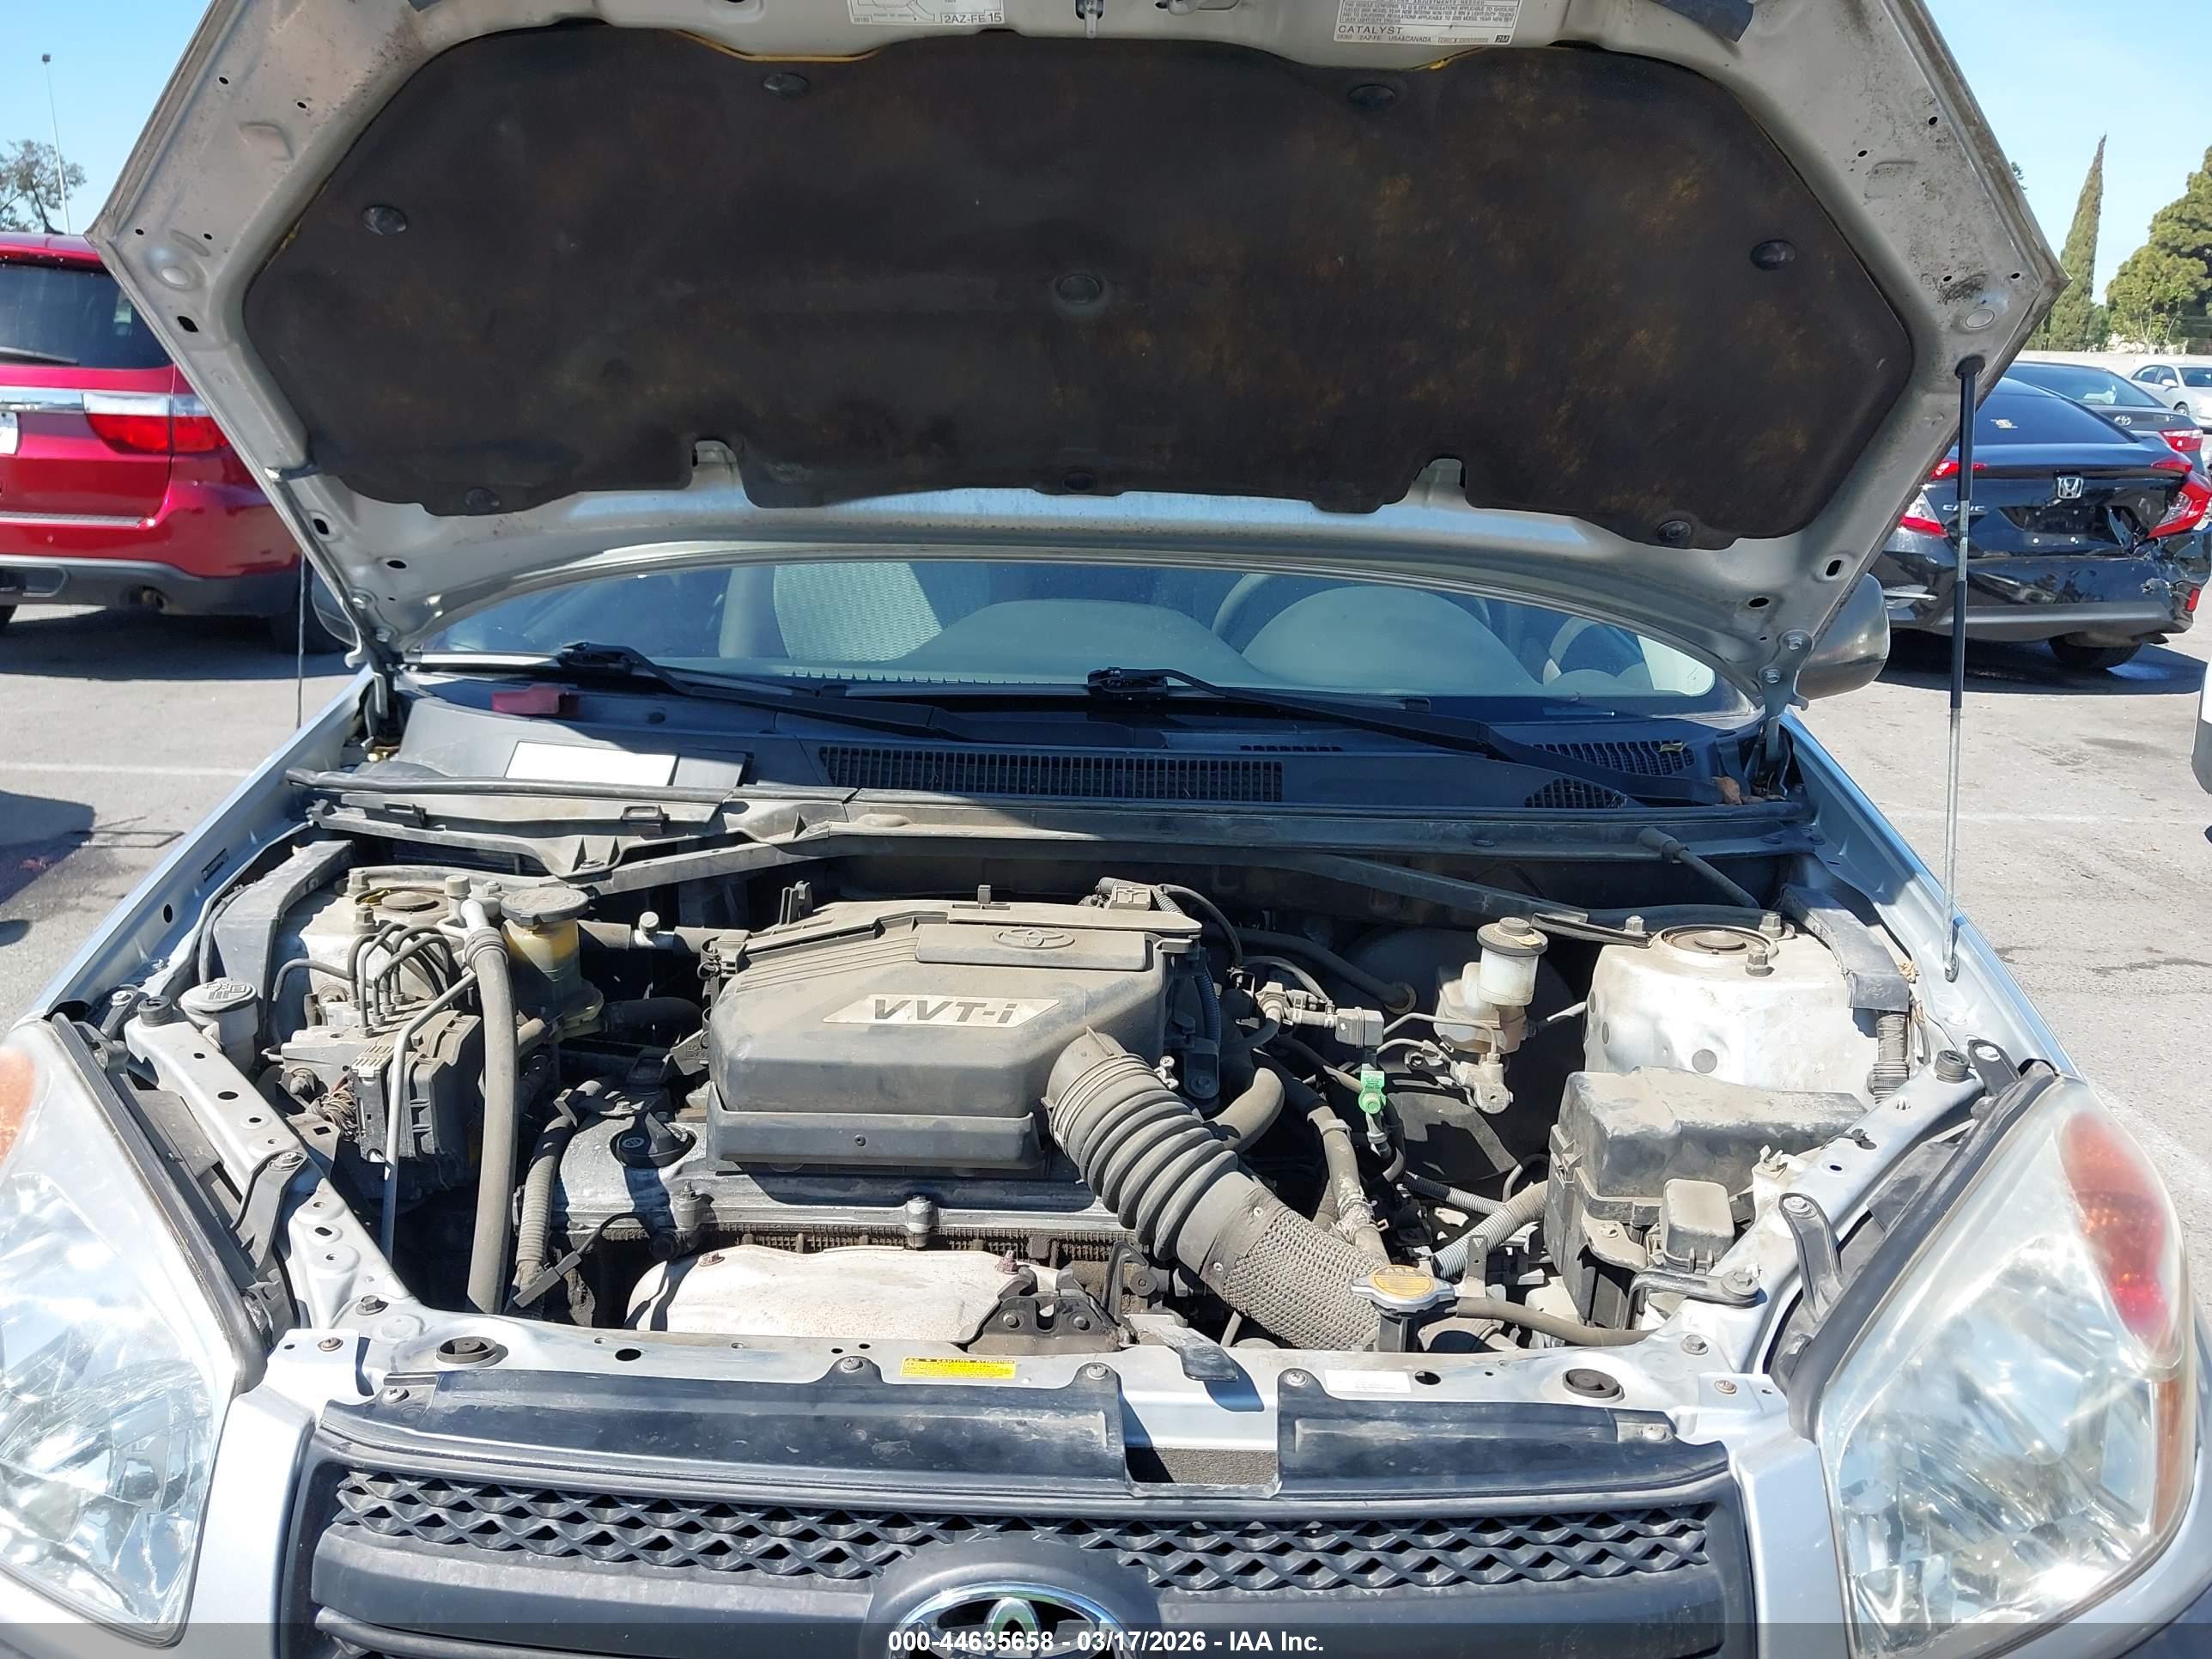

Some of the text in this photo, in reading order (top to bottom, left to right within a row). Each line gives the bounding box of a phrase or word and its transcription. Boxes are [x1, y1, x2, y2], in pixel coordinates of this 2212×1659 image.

[944, 12, 1002, 23] 2AZ-FE 15
[1338, 25, 1403, 34] CATALYST
[874, 999, 1018, 1024] VVT-i
